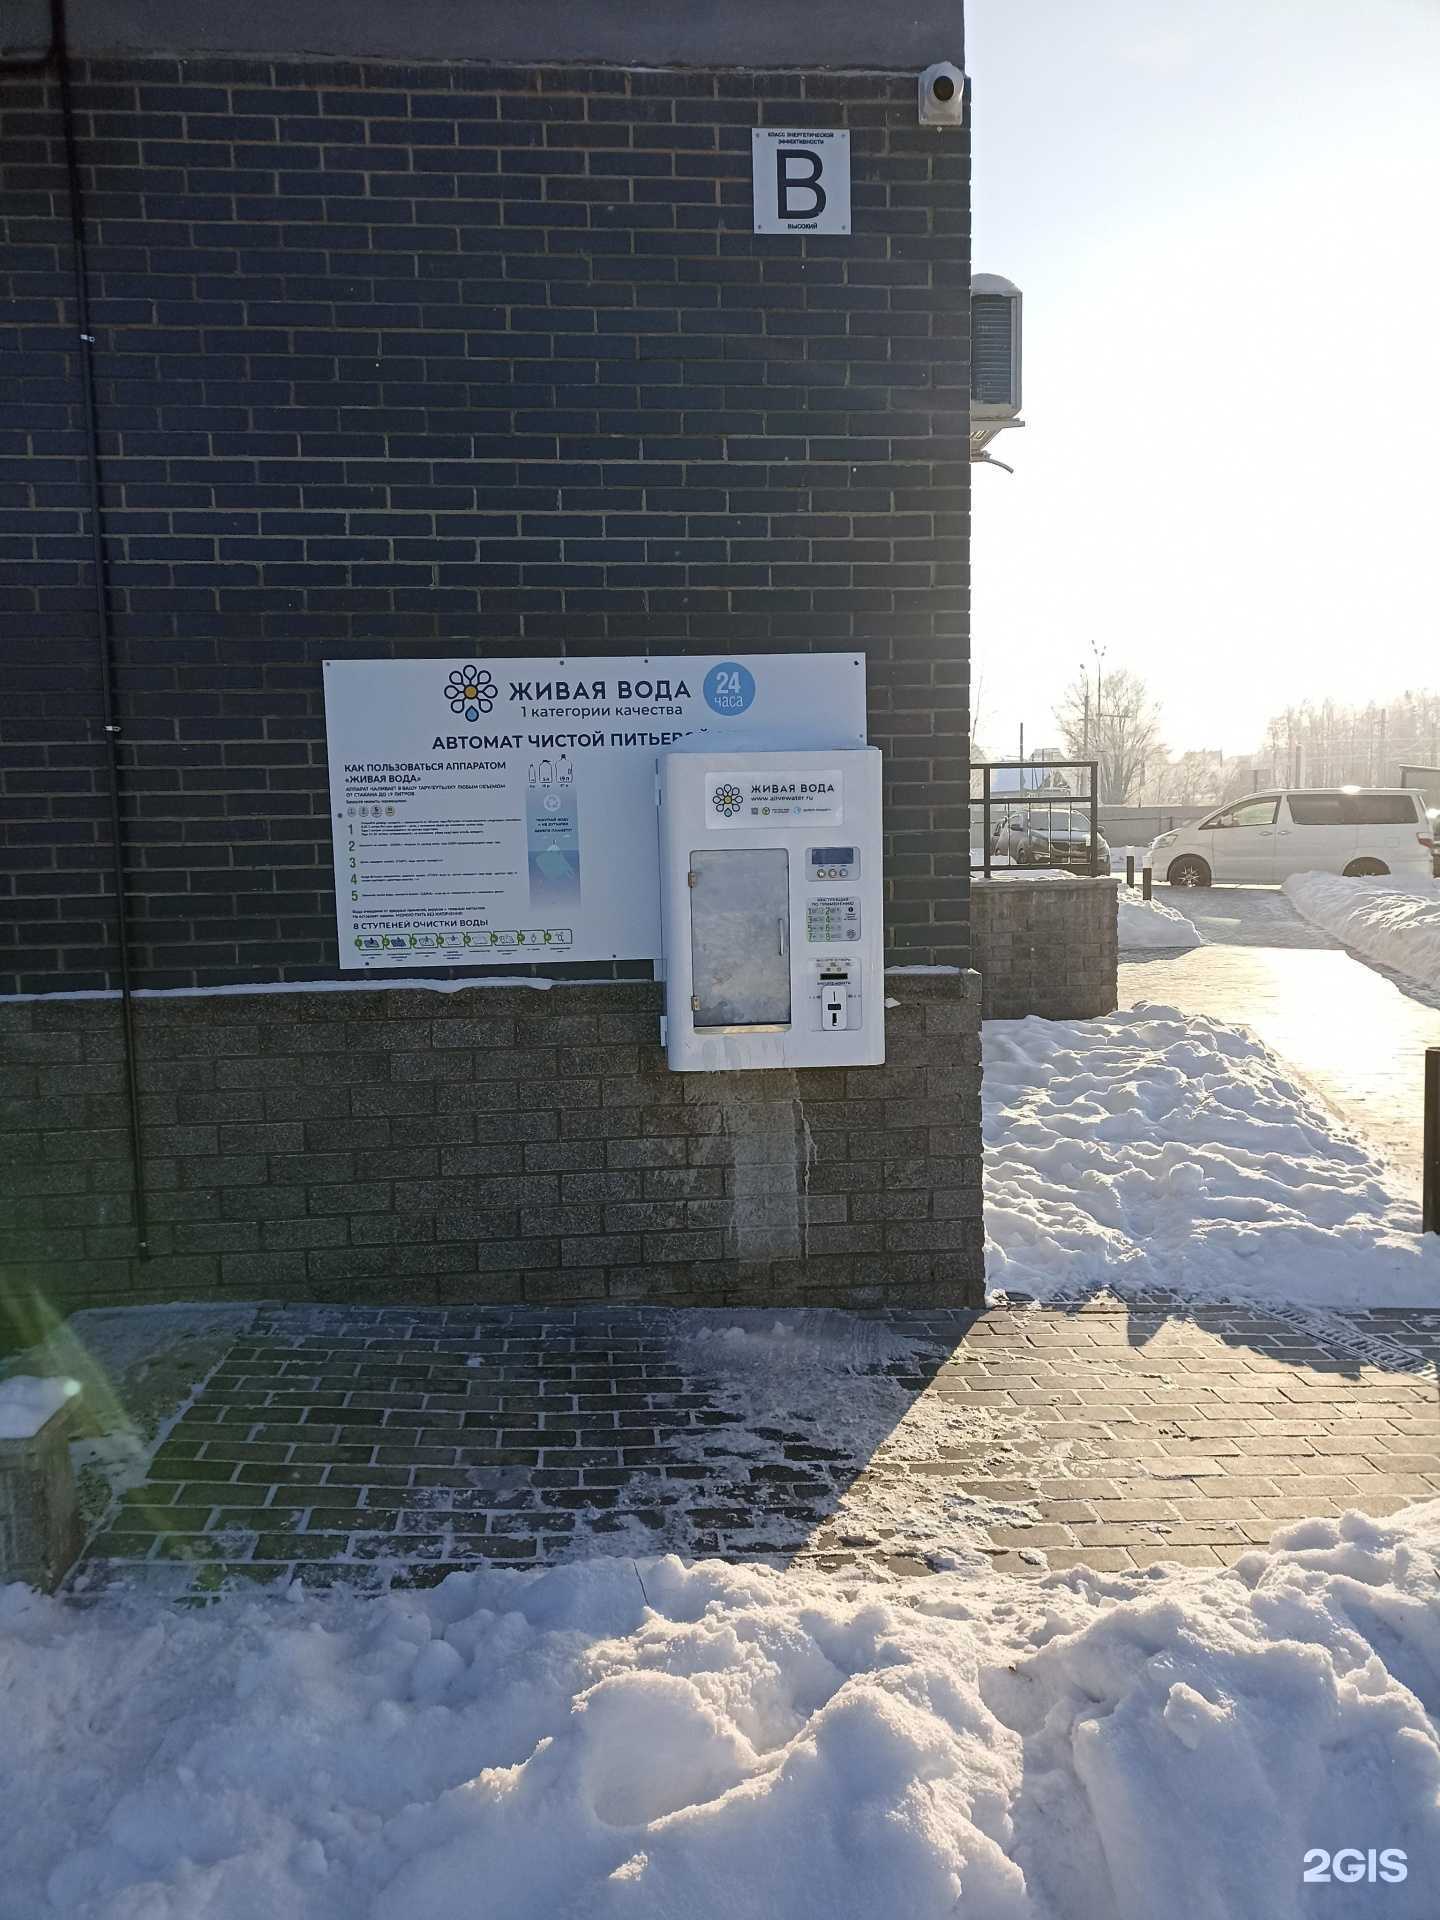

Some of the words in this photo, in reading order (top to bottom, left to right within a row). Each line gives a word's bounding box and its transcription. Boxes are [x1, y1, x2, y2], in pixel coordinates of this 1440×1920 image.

[777, 149, 826, 219] B
[788, 222, 818, 230] ВЫСОКИЙ
[716, 671, 741, 694] 24
[509, 681, 606, 701] ЖИВАЯ
[618, 680, 691, 701] ВОДА
[714, 696, 744, 708] часа
[521, 706, 527, 717] 1
[532, 706, 611, 719] категории
[615, 705, 683, 716] качества
[432, 735, 523, 750] АВТОМАТ
[528, 731, 605, 748] ЧИСТОЙ
[611, 729, 707, 747] ПИТЬЕВ
[344, 764, 365, 773] КАК
[367, 763, 444, 772] ПОЛЬЗОВАТЬСЯ
[446, 761, 506, 771] АППАРАТОМ
[751, 784, 796, 793] ЖИВАЯ
[800, 783, 835, 793] ВОДА
[349, 824, 353, 835] 1
[349, 841, 355, 852] 2
[350, 858, 356, 869] 3
[351, 874, 357, 885] 4
[352, 891, 358, 901] 5
[353, 922, 359, 930] 8
[361, 920, 410, 930] СТУПЕНЕЙ
[412, 920, 457, 928] ОЧИСТКИ
[460, 919, 489, 928] ВОДЫ
